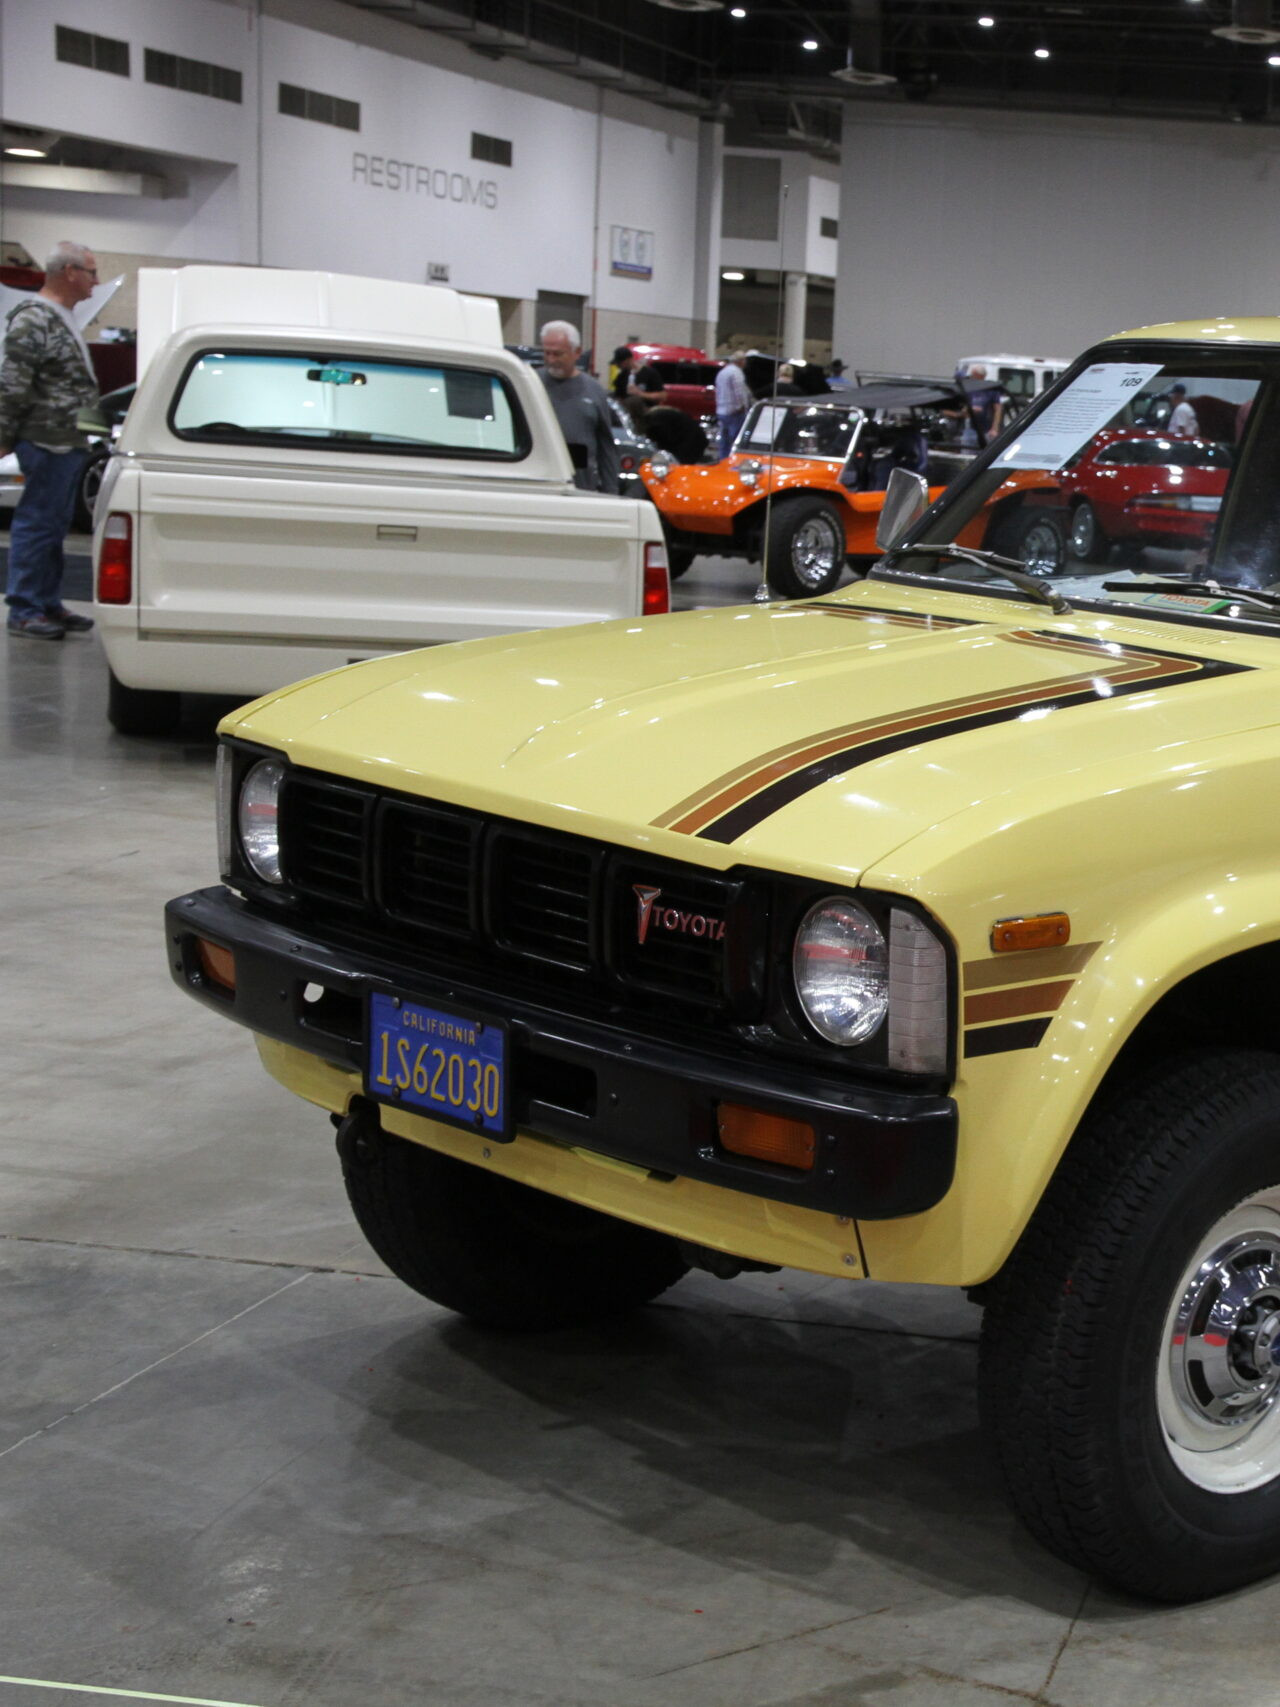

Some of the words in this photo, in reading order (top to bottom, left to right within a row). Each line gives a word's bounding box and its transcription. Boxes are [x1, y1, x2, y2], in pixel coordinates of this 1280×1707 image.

[352, 151, 498, 210] RESTROOMS
[1119, 377, 1143, 387] 109
[402, 1010, 476, 1047] CALIFORNIA
[376, 1031, 500, 1118] 1S62030
